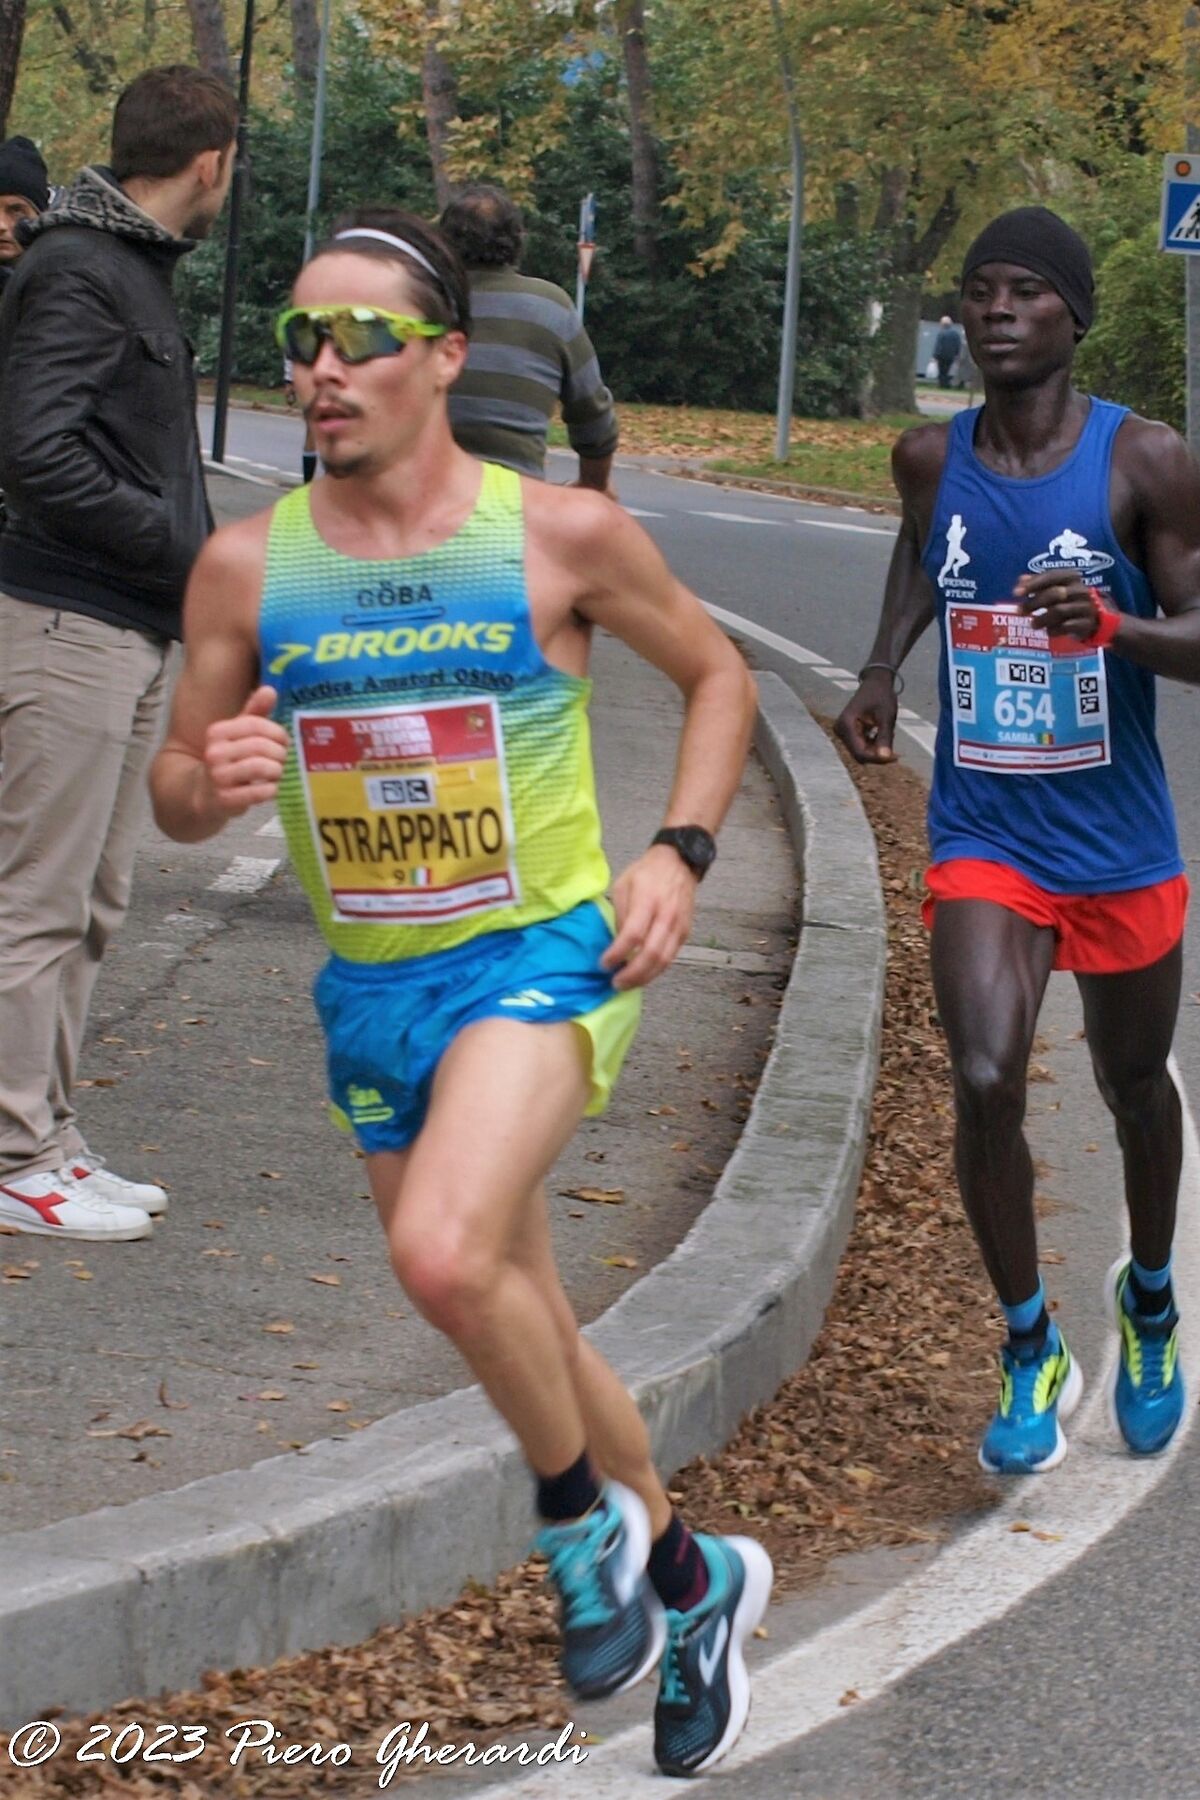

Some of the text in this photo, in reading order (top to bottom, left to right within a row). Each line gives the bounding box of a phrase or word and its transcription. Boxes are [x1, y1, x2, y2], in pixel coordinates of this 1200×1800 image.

[1042, 560, 1076, 569] ATLETICA
[314, 621, 516, 664] BROOKS
[994, 689, 1056, 729] 654
[997, 731, 1037, 745] SAMBA
[318, 807, 504, 864] STRAPPATO
